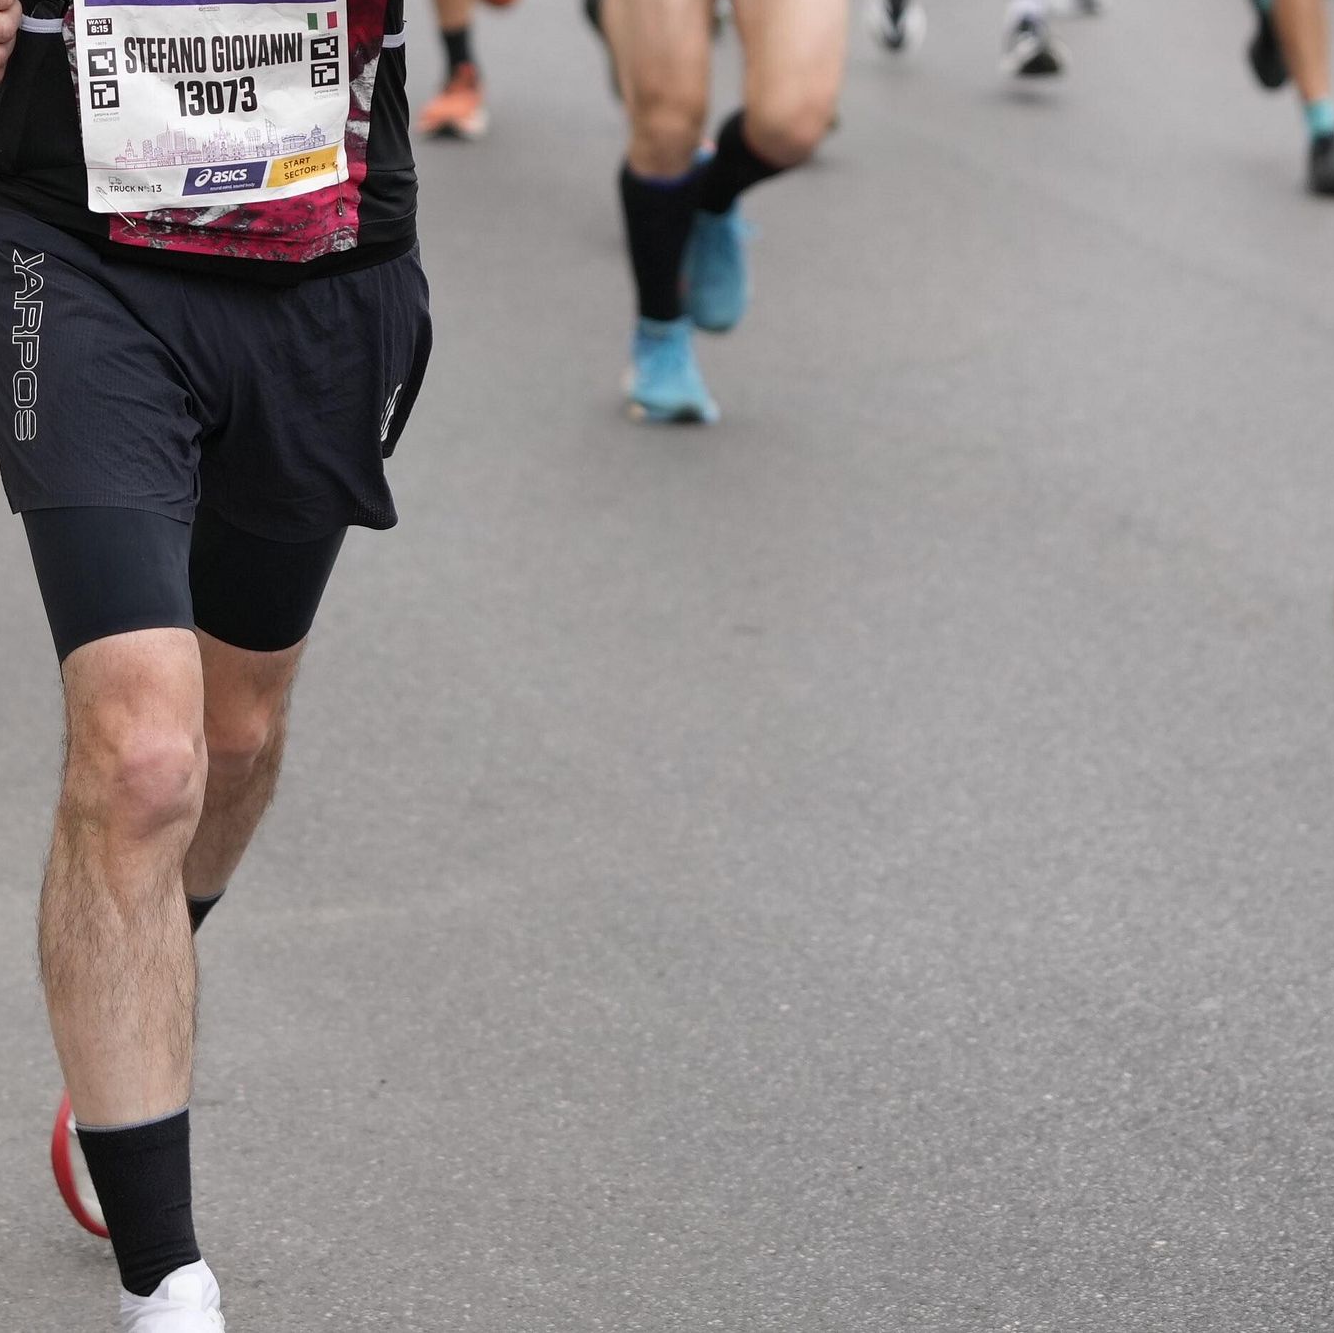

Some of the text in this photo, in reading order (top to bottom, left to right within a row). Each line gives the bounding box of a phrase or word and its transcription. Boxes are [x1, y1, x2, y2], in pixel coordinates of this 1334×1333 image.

[91, 24, 109, 33] 8:15
[123, 32, 303, 74] STEFANO GIOVANNI
[174, 76, 258, 117] 13073
[283, 156, 311, 170] START
[211, 168, 248, 184] asics
[284, 164, 319, 180] SECTOR:
[109, 185, 136, 193] TRUCK
[151, 184, 162, 193] 13
